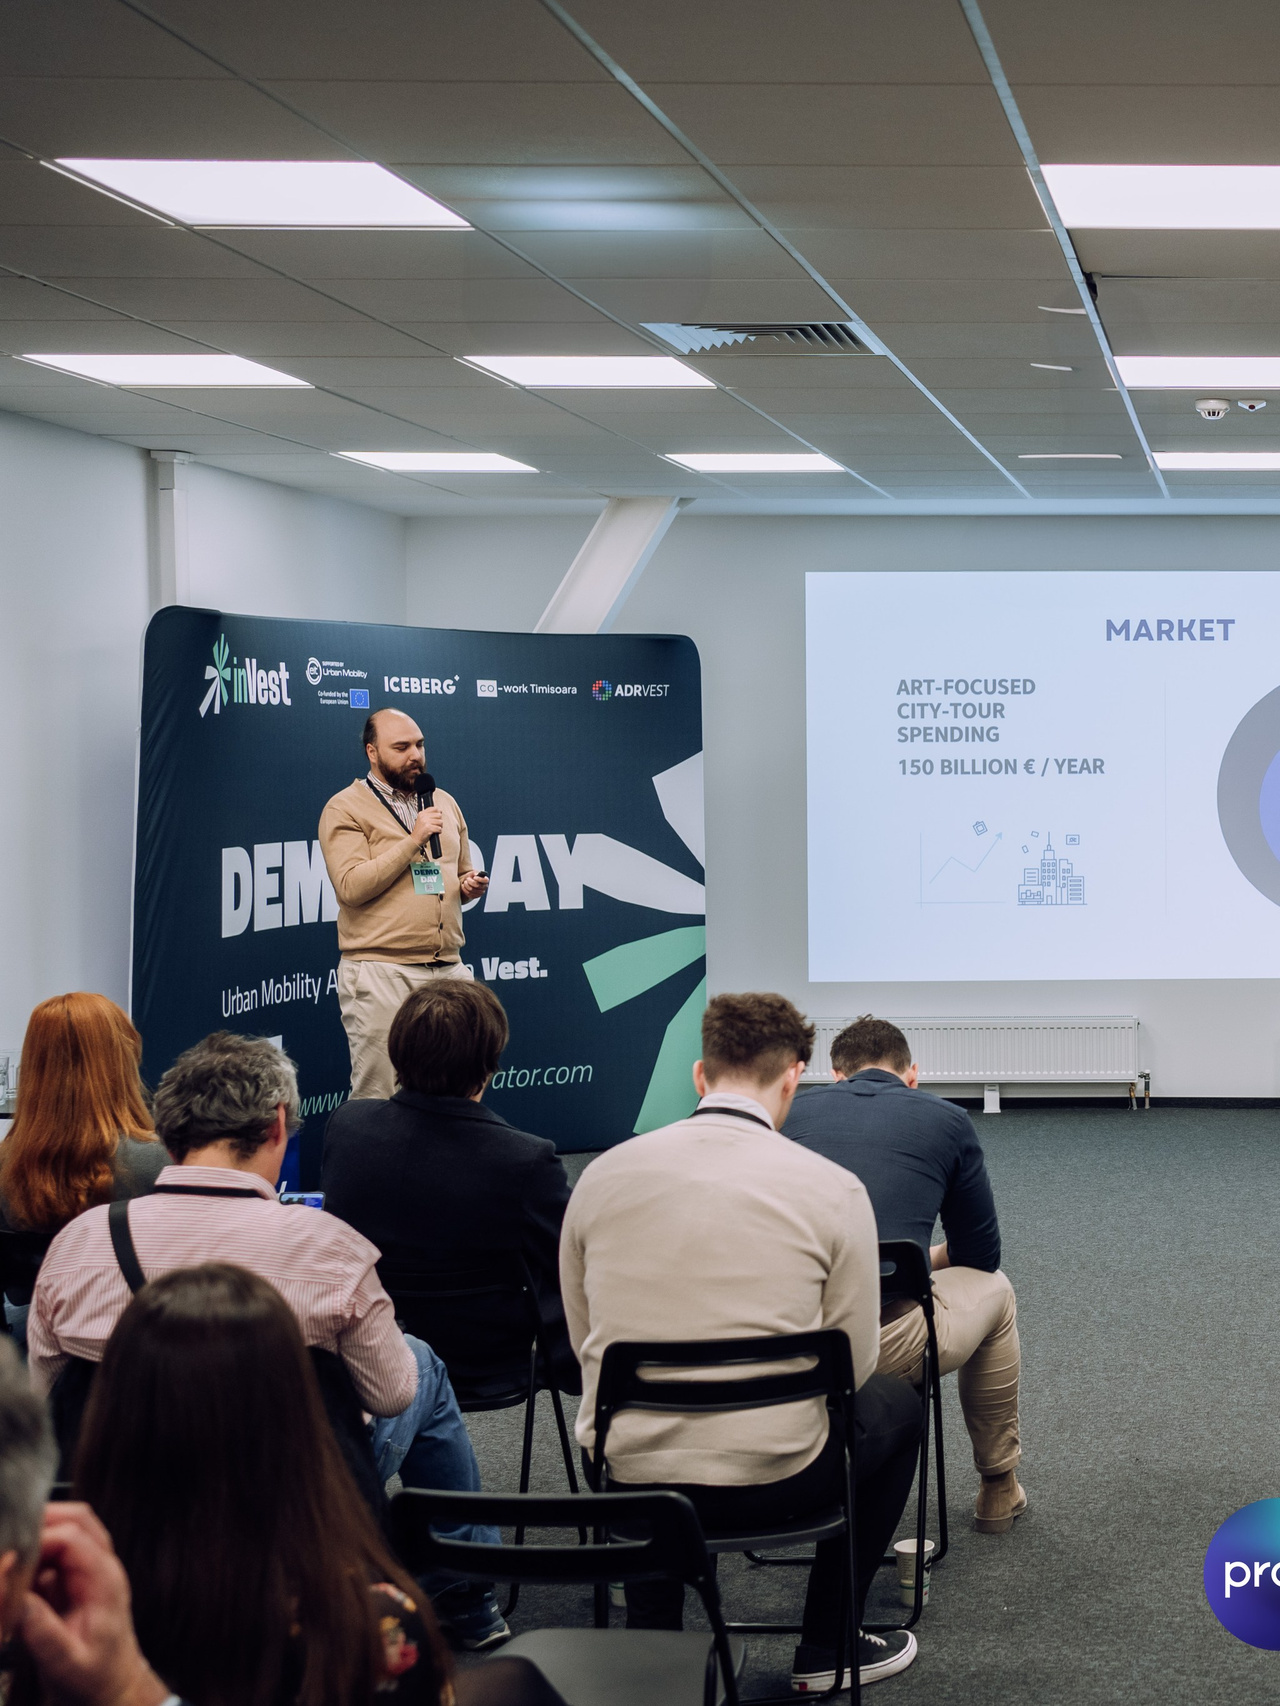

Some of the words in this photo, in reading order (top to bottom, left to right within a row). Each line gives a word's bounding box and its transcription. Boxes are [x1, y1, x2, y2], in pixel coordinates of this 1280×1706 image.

[1105, 618, 1236, 641] MARKET
[233, 657, 292, 706] inVest
[323, 668, 342, 676] Urban
[343, 669, 368, 679] Mobility
[530, 684, 578, 695] Timisoara
[614, 684, 670, 697] ADRVEST
[896, 678, 1036, 696] ART-FOCUSED
[896, 702, 1006, 720] CITY-TOUR
[896, 726, 1000, 743] SPENDING
[898, 758, 934, 775] 150
[940, 758, 1018, 775] BILLION
[1053, 758, 1105, 774] YEAR
[221, 838, 339, 938] DEM
[481, 957, 548, 981] Vest.
[221, 980, 258, 1018] Urban
[261, 971, 322, 1006] Mobility
